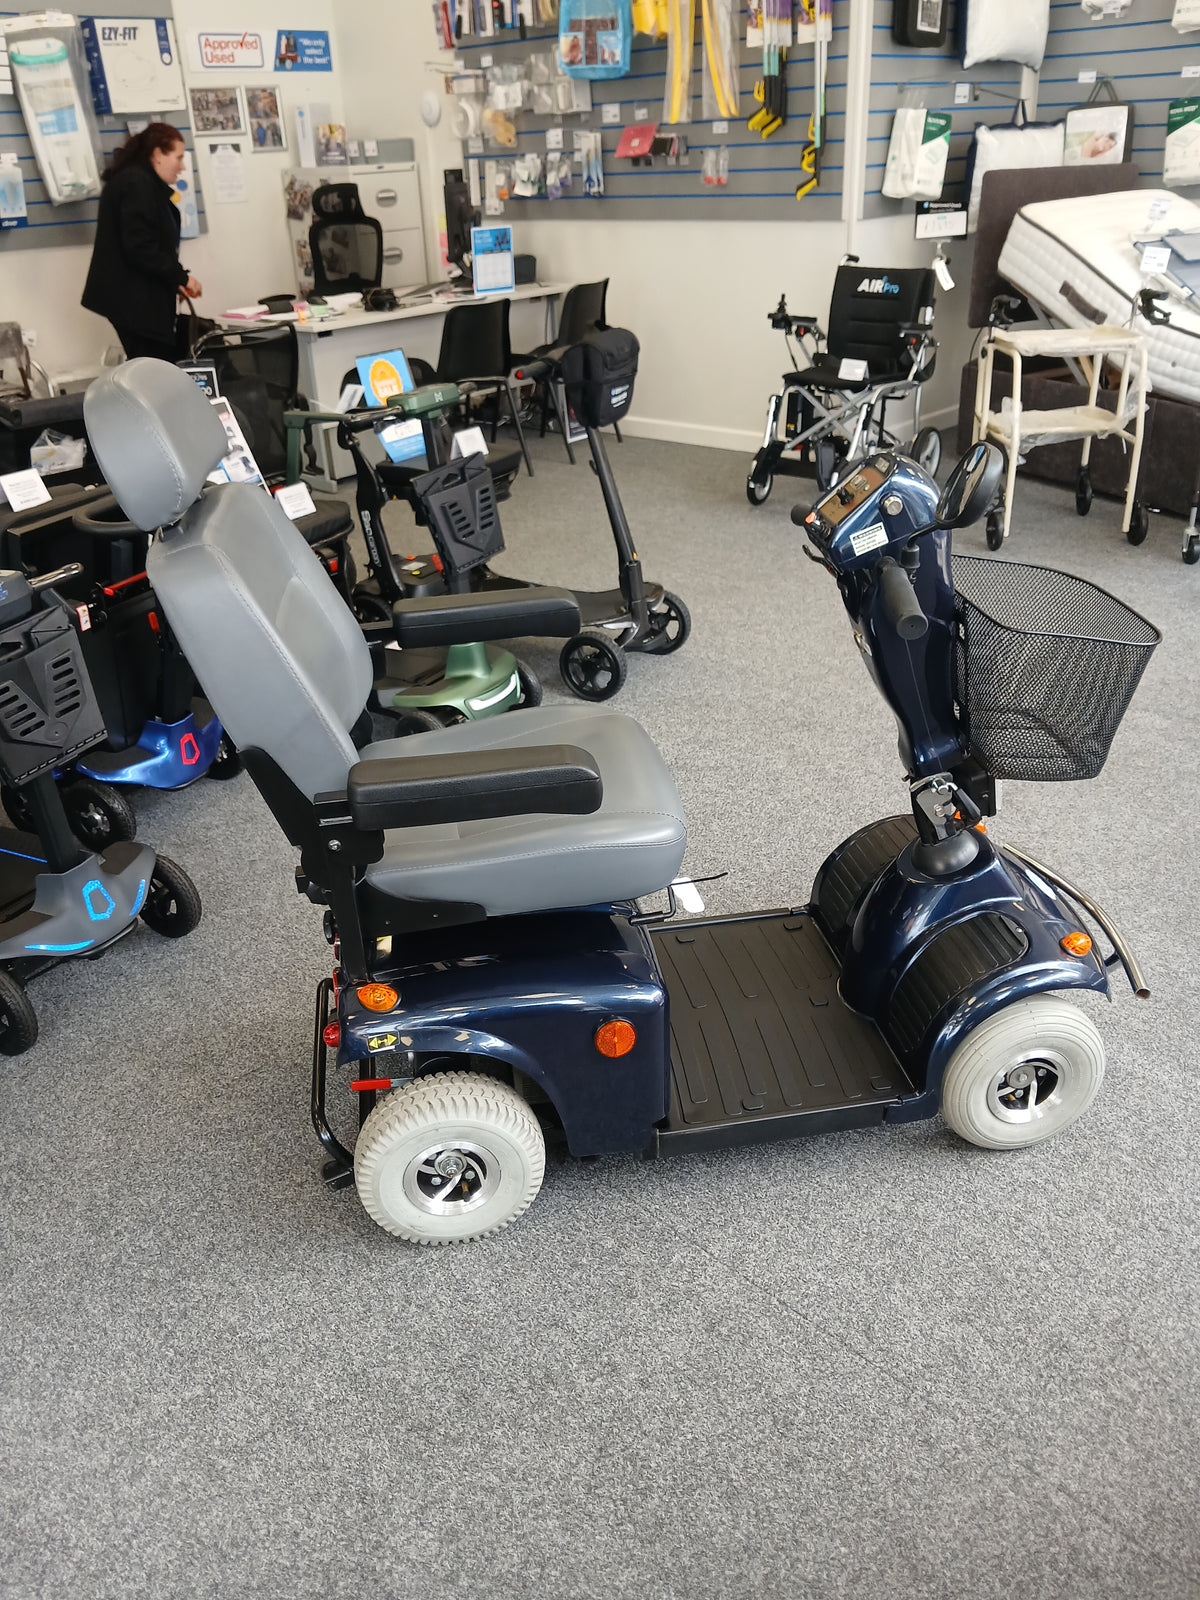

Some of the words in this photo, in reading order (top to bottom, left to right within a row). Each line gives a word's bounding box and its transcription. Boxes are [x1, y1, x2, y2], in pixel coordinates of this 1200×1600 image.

[101, 26, 138, 41] EZY-FIT
[203, 36, 258, 51] Approved
[205, 51, 235, 63] Used
